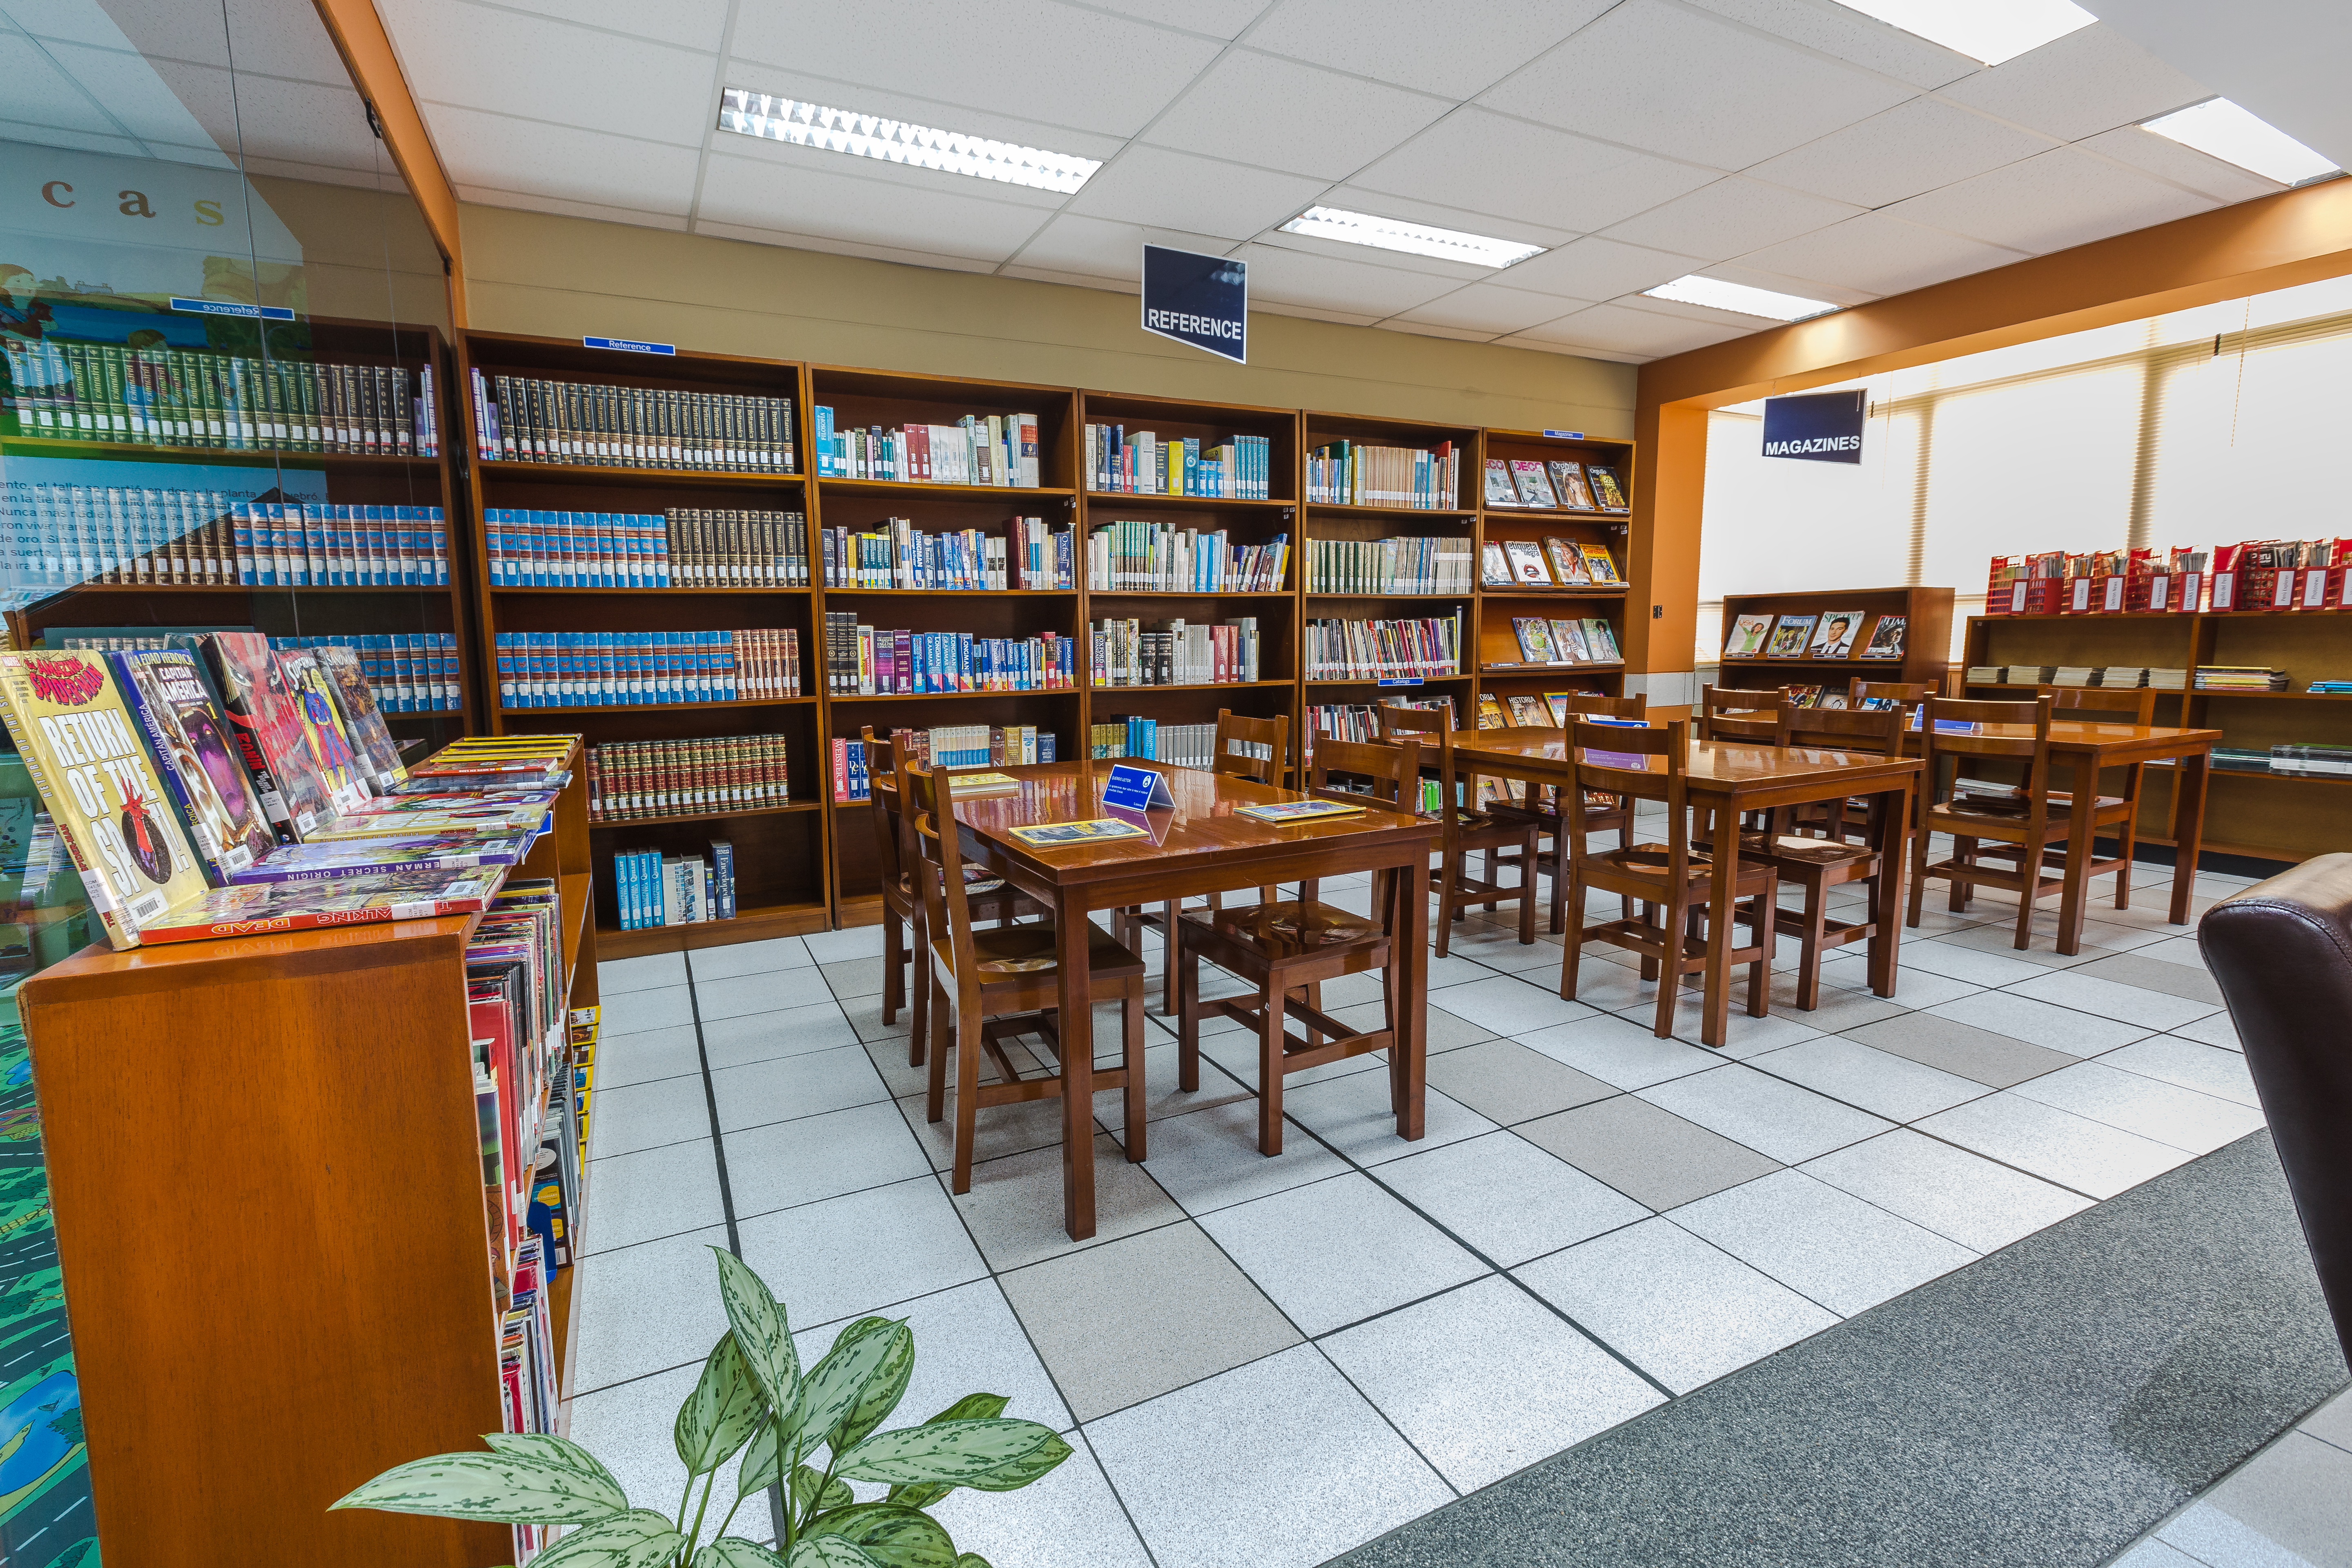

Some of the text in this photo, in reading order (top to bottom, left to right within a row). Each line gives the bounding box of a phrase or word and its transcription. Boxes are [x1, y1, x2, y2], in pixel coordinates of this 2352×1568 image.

[1149, 308, 1241, 340] REFERENCE
[608, 340, 651, 352] Reference
[545, 394, 553, 425] Britannica
[1765, 435, 1860, 456] MAGAZINES
[1515, 461, 1542, 472] DECO
[1552, 461, 1579, 471] Orgullo
[21, 494, 32, 503] la
[221, 489, 256, 501] planta
[1508, 542, 1538, 554] etiqueta
[1, 561, 11, 569] la
[2311, 576, 2319, 600] Photonews
[1781, 616, 1813, 625] FORUM
[36, 656, 83, 677] AMAZING
[139, 653, 161, 666] EDAD
[326, 654, 358, 666] SANDMAN
[286, 656, 317, 690] SUPERMAN
[30, 662, 104, 706] SPIDER-MAN
[1508, 695, 1537, 704] HISTORIA
[206, 702, 218, 719] 1
[4, 713, 22, 734] THE
[16, 739, 30, 751] OF
[38, 708, 137, 768] RETURN
[138, 703, 175, 771] CAPITÁN AMÉRICA
[833, 739, 843, 782] WEBSTER'S
[25, 756, 54, 799] RETURN
[66, 755, 157, 818] OF THE
[287, 861, 440, 881] ERMAN SECRET ORIGIN
[720, 858, 731, 900] Encyclopedi
[211, 907, 392, 934] ALKING DEAD
